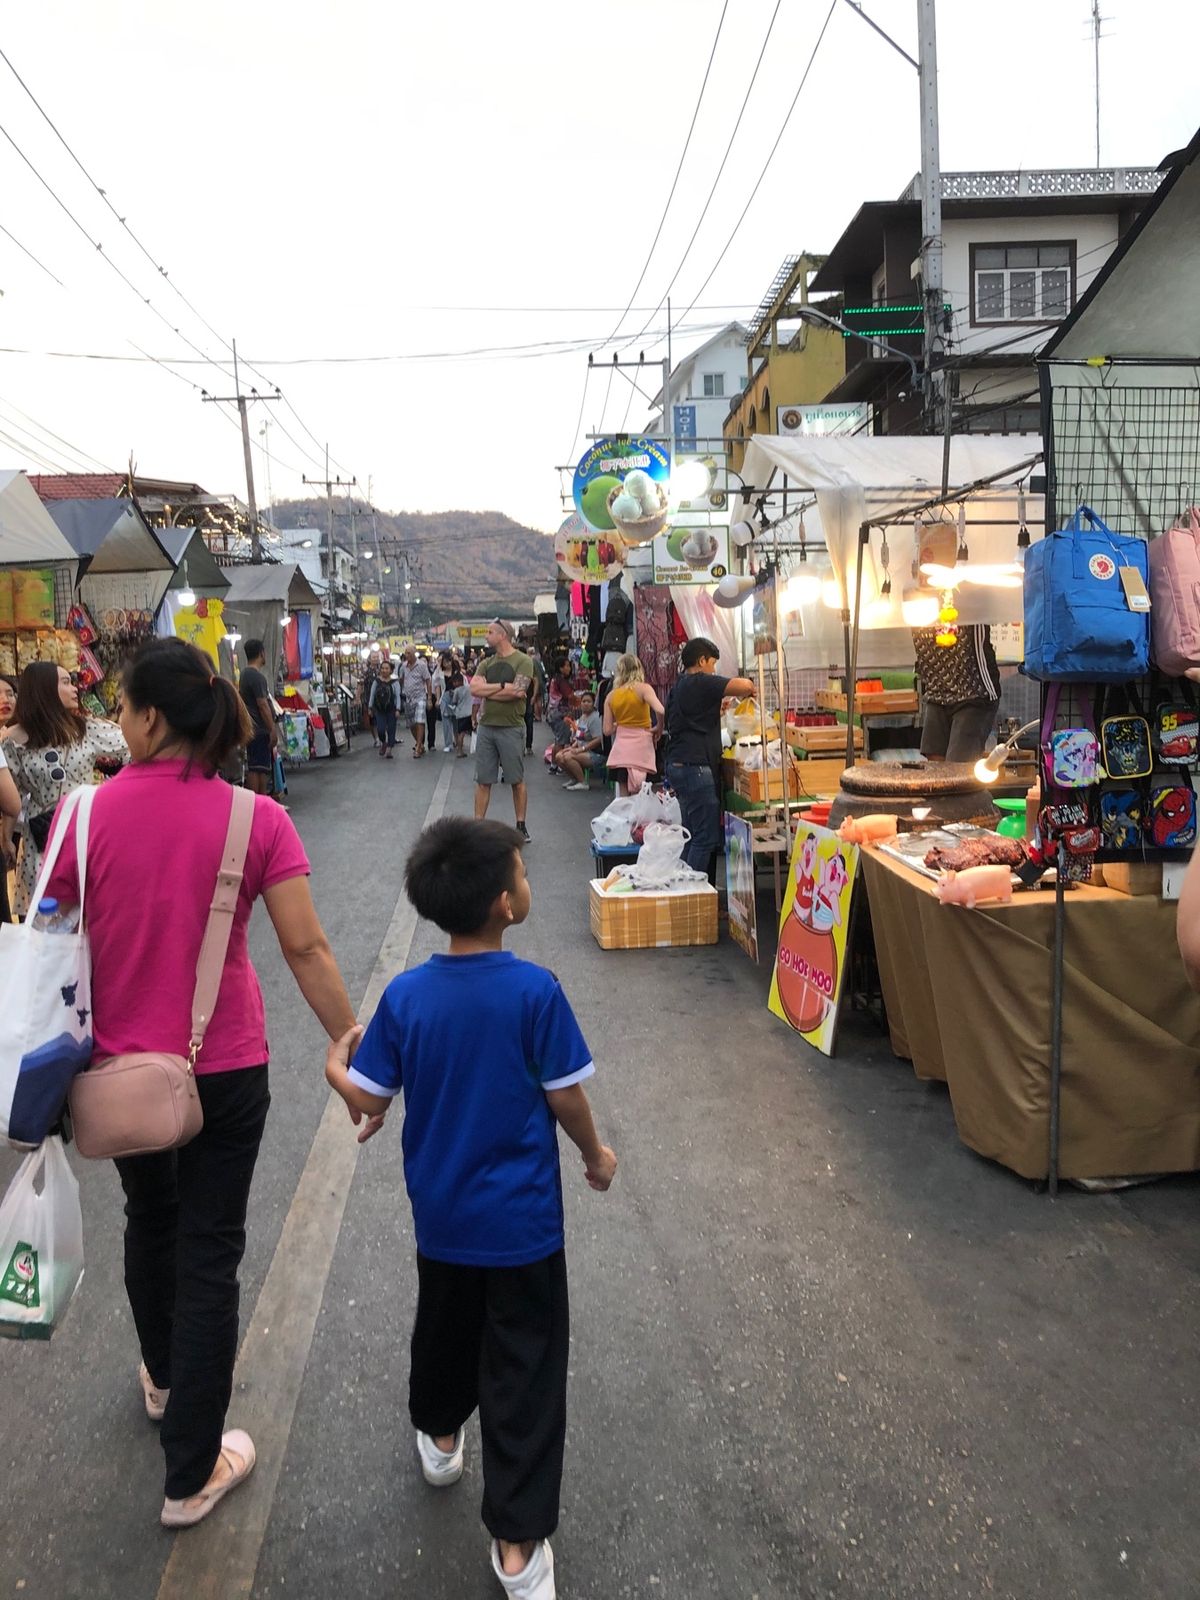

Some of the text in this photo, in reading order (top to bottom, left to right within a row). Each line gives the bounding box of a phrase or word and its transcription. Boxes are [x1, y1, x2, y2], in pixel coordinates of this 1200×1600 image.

[680, 407, 690, 448] HOTEL
[579, 441, 613, 478] Coconut
[713, 566, 723, 576] 40
[1162, 713, 1178, 731] 95
[780, 946, 791, 965] GO
[811, 967, 832, 993] HOO
